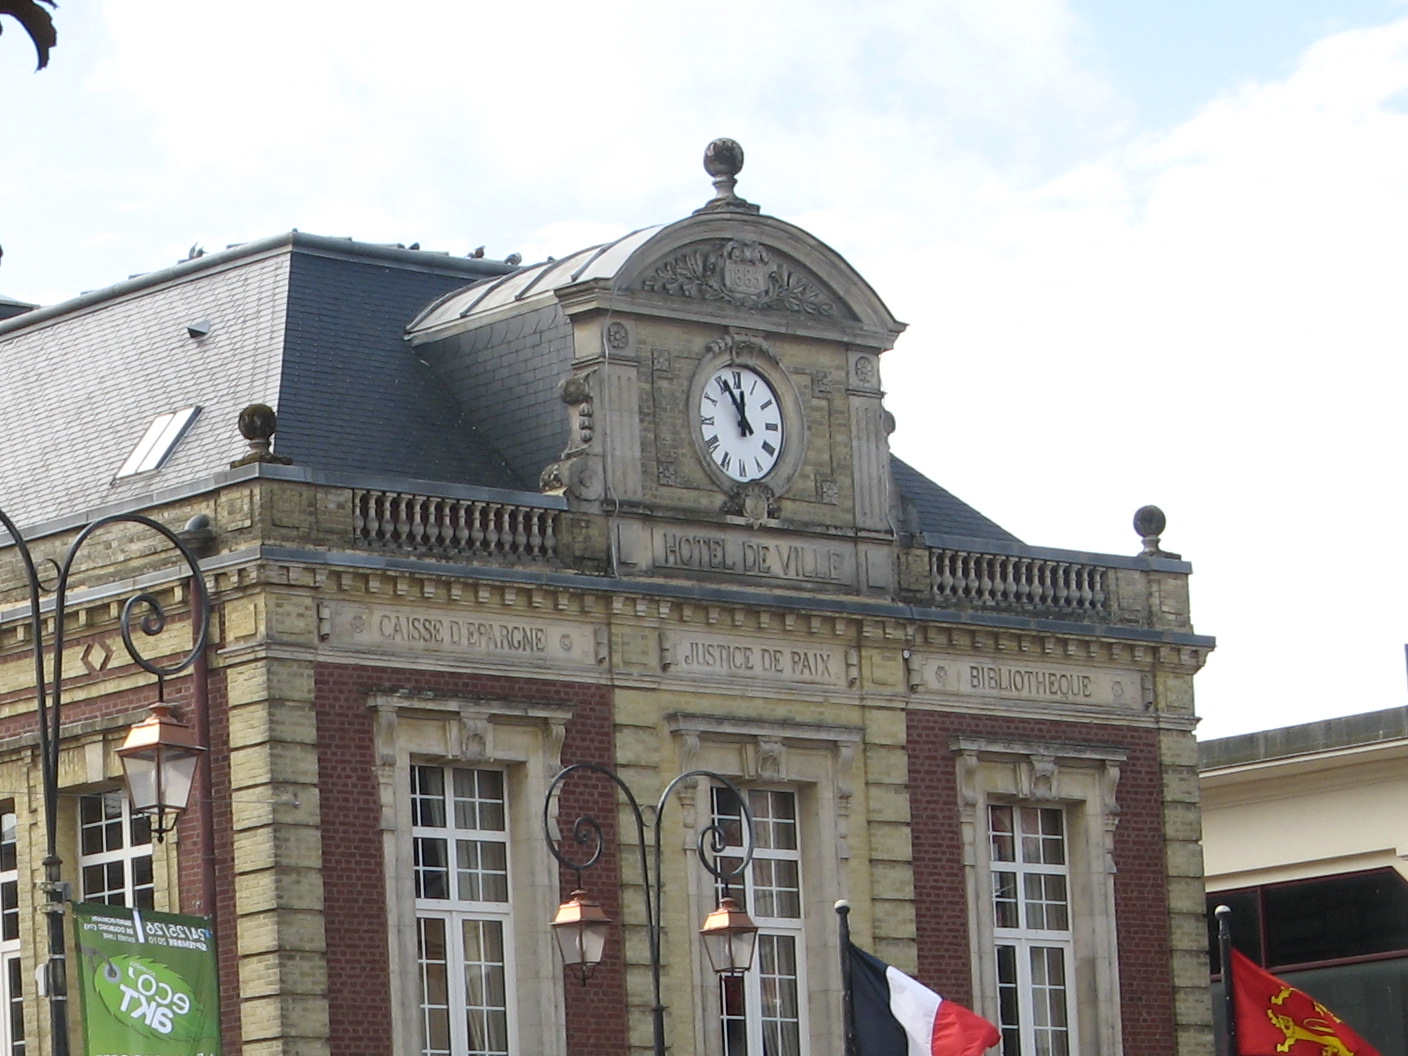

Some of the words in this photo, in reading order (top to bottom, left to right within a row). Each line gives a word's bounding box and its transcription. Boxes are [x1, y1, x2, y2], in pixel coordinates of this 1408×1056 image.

[664, 532, 736, 570] HOTEL
[742, 541, 772, 573] DE
[775, 544, 842, 580] VILLE
[380, 614, 444, 643] CAISSE
[449, 620, 546, 652] D'EPARGNE
[684, 642, 754, 669] JUSTICE
[761, 649, 784, 672] DE
[791, 651, 832, 677] PAIX
[969, 665, 1092, 699] BIBLIOTHEQUE
